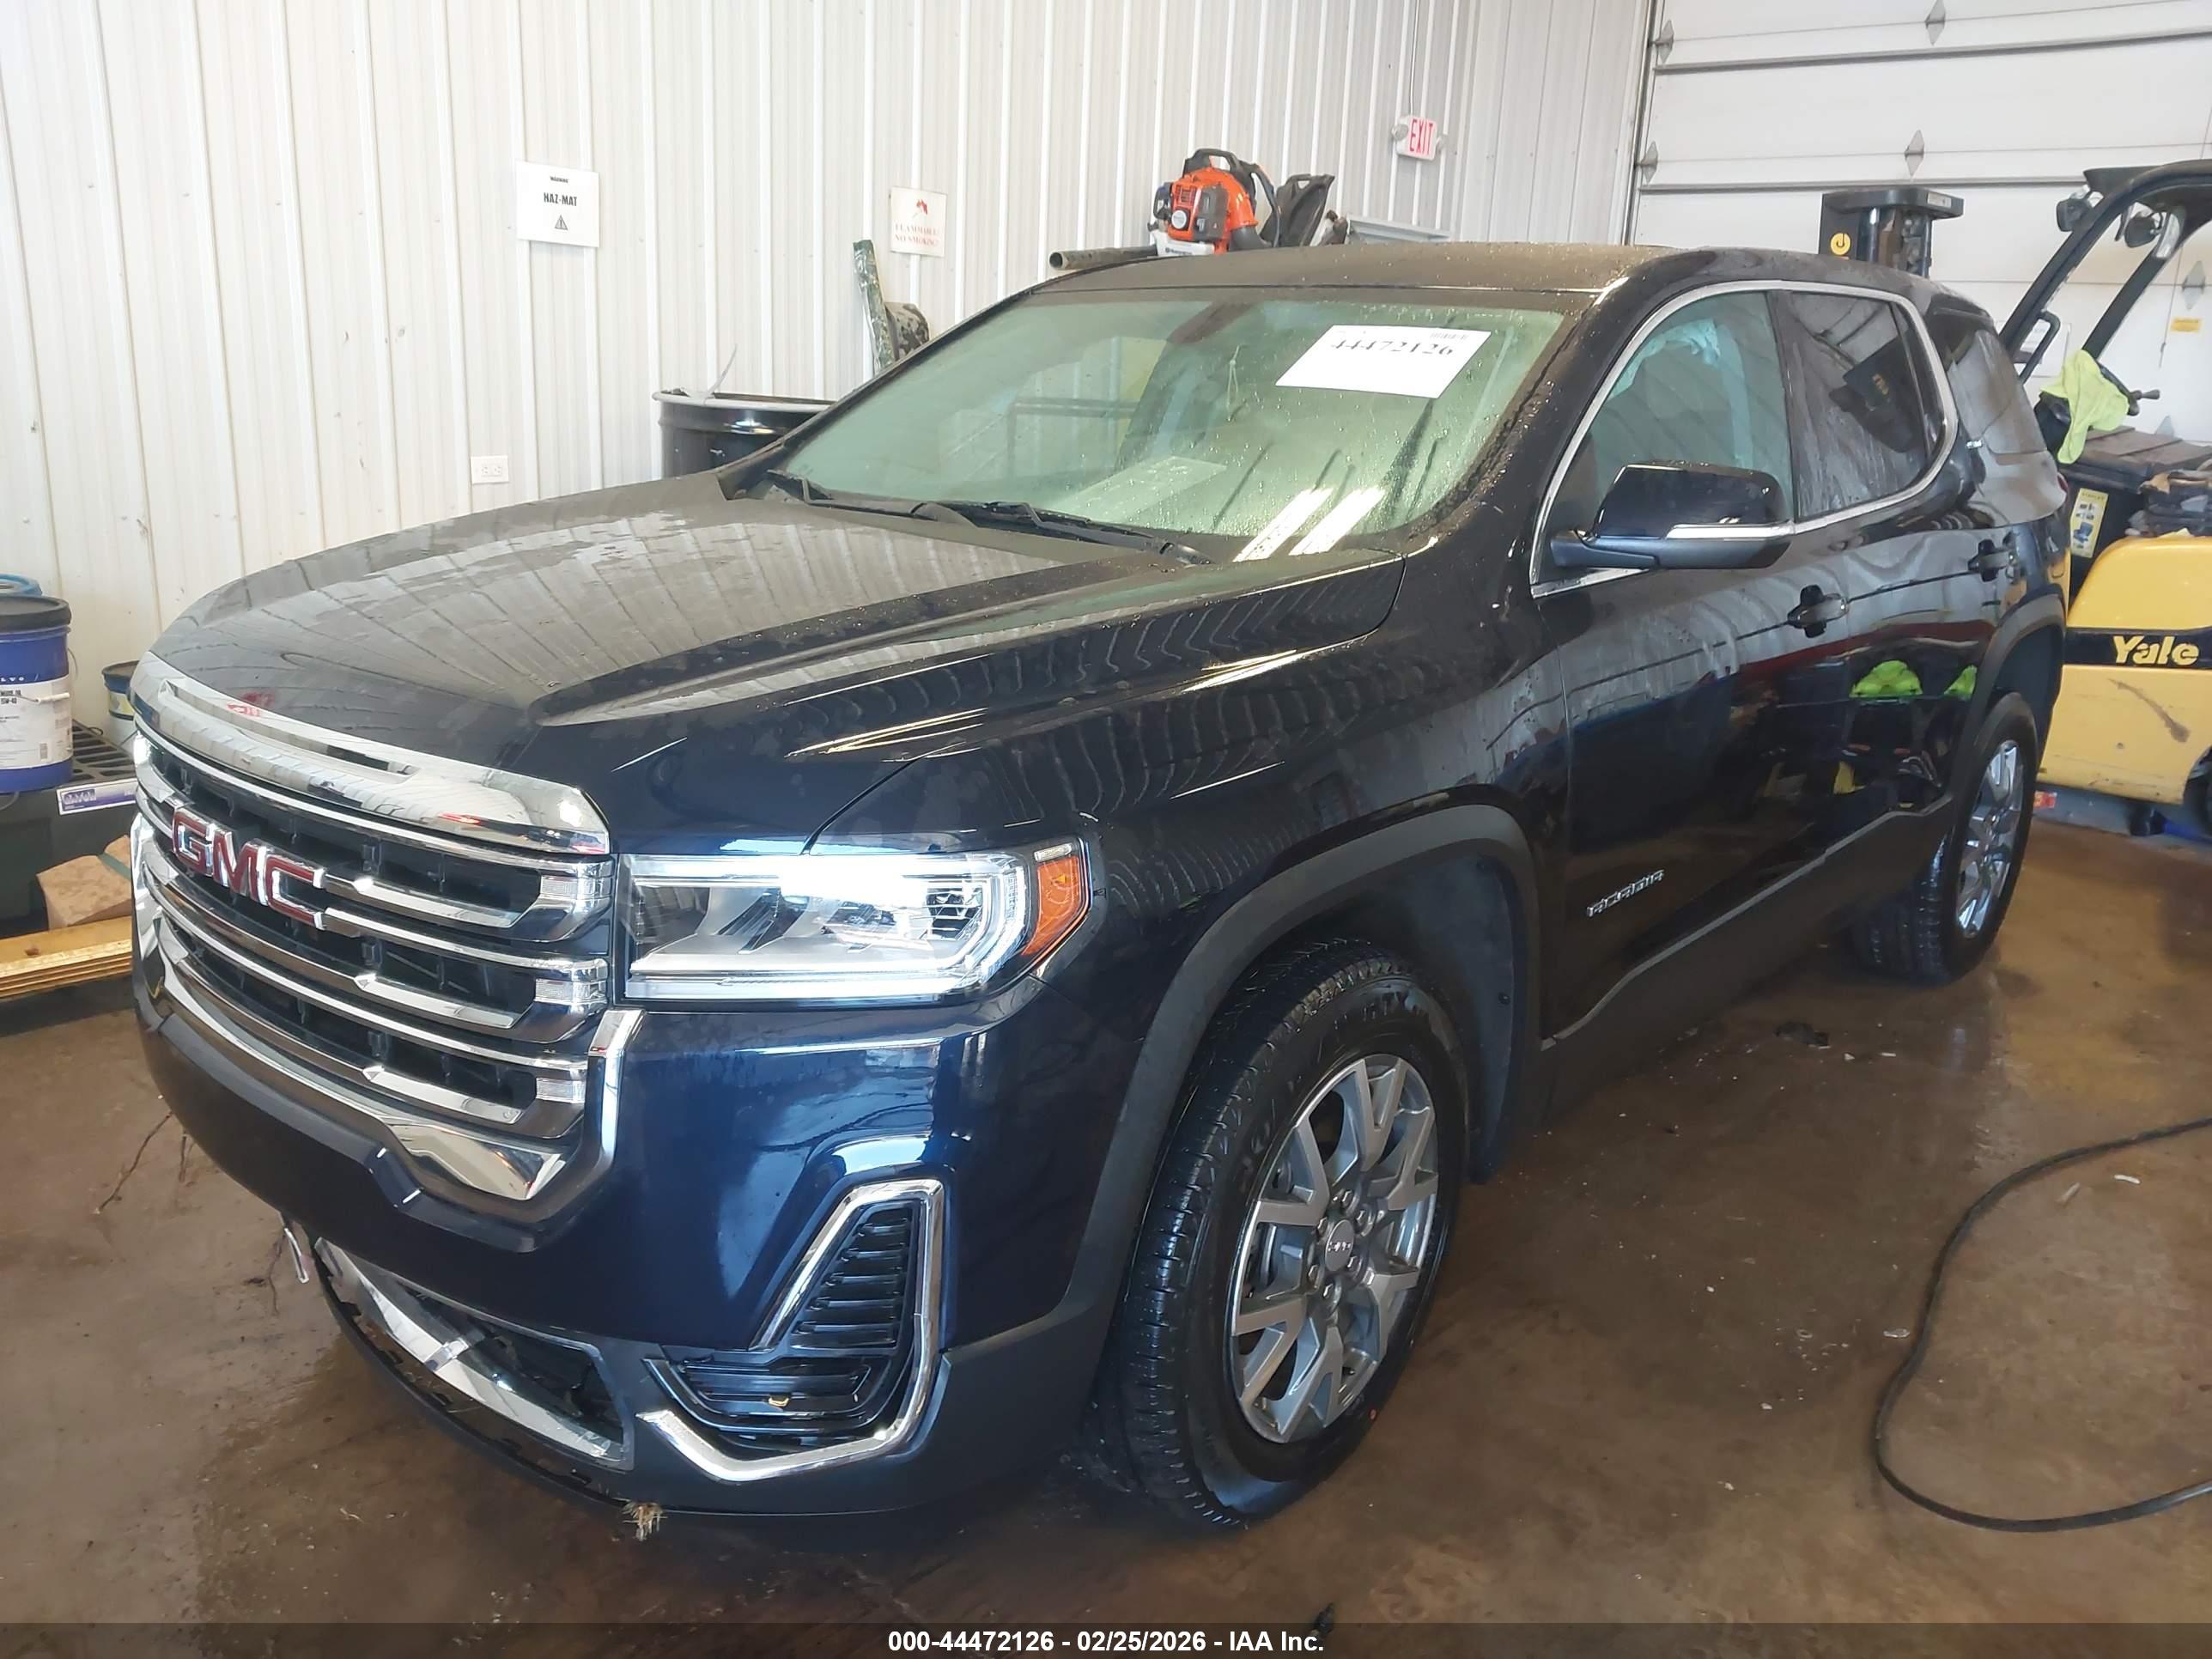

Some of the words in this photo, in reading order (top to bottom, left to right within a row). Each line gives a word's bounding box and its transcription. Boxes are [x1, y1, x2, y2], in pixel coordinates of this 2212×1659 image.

[1409, 118, 1433, 155] EXIT
[544, 191, 577, 206] HAZ-MAT
[1331, 339, 1454, 356] 44472126
[2113, 635, 2199, 666] Yale
[172, 804, 327, 930] GMC
[1587, 869, 1665, 917] ACADIA
